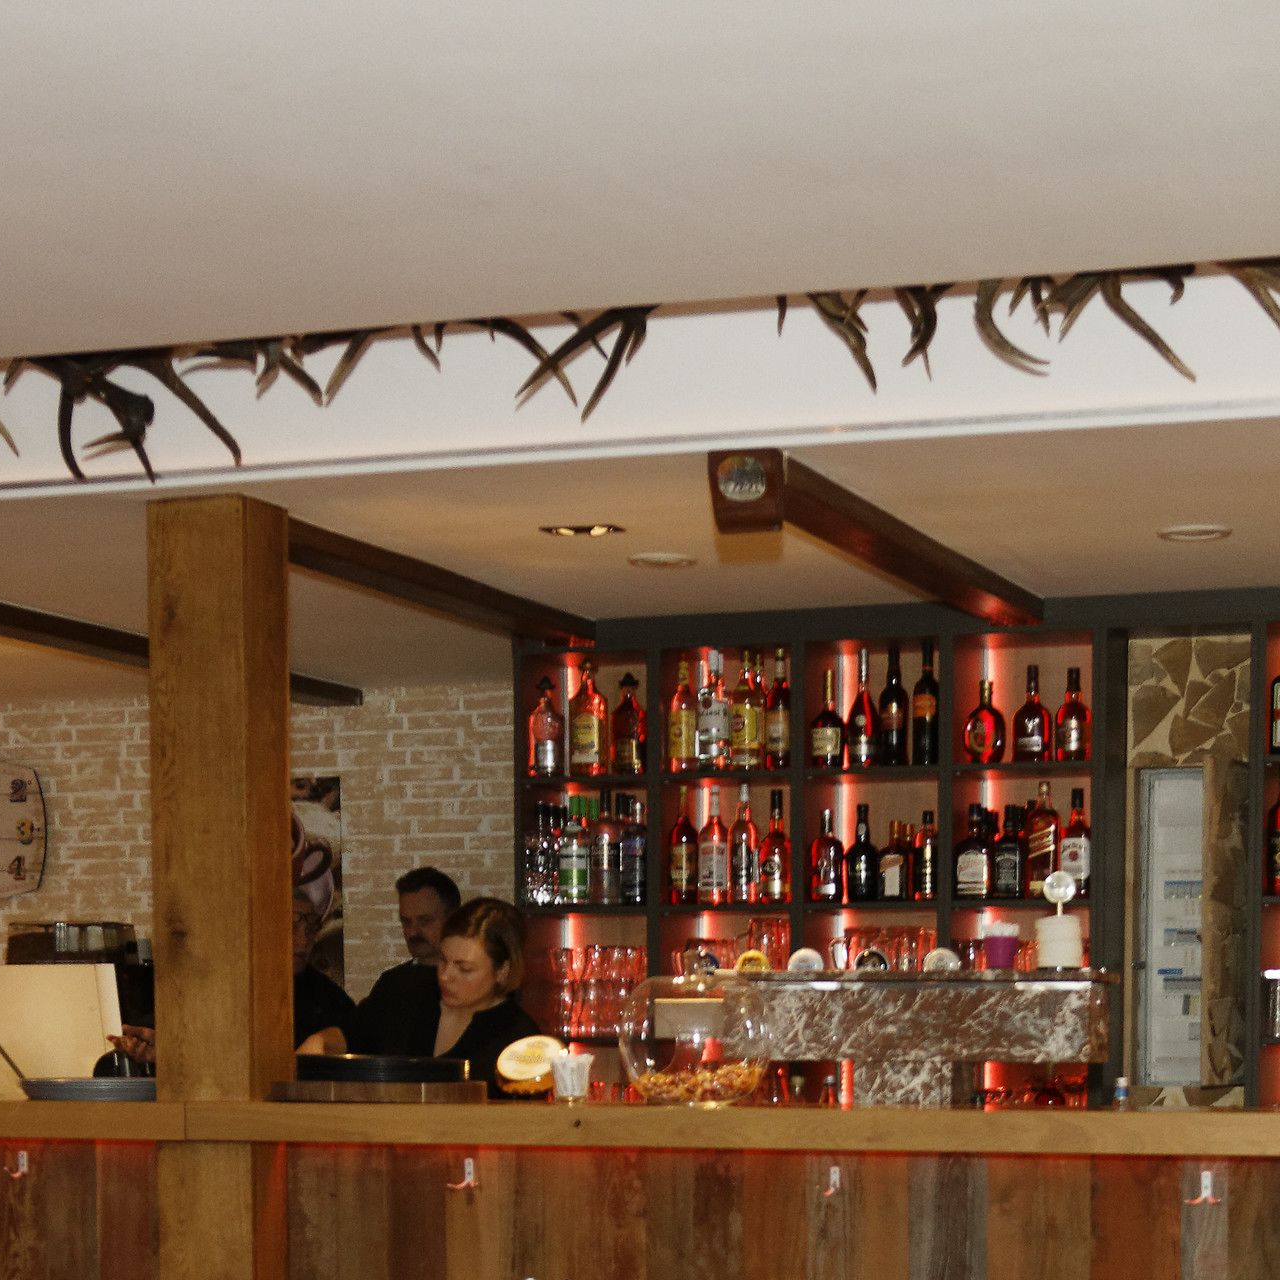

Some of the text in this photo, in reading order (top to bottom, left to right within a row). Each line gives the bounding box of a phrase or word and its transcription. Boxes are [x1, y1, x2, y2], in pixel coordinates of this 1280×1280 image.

[10, 779, 27, 802] 2
[16, 819, 34, 845] 3
[8, 855, 26, 881] 4
